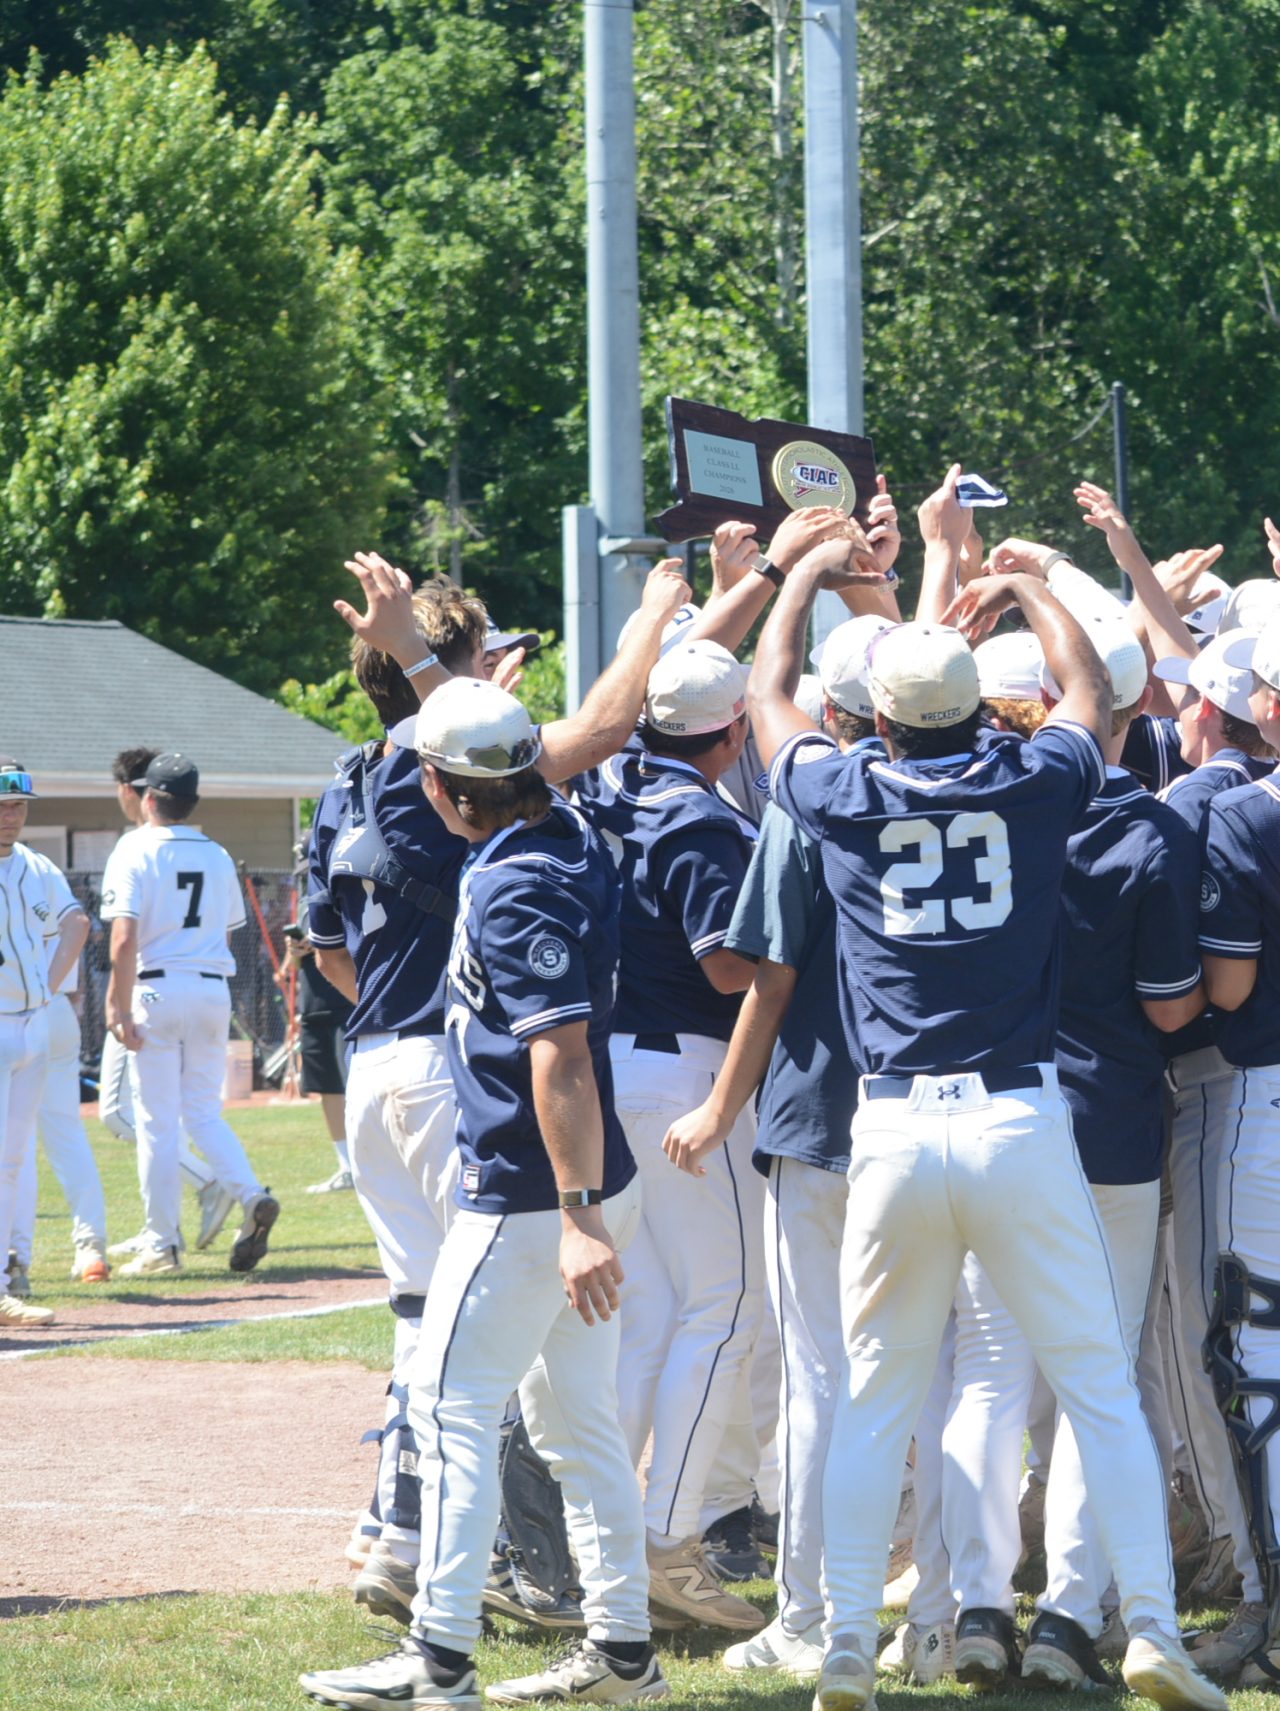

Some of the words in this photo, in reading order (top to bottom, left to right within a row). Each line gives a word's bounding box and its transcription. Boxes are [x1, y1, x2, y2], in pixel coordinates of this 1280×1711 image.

[703, 444, 741, 459] BASEBALL
[706, 457, 730, 469] CLASS
[731, 462, 741, 471] LL
[703, 468, 747, 484] CHAMPIONS
[921, 706, 961, 721] WRECKERS
[878, 811, 1013, 935] 23
[176, 871, 205, 929] 7
[543, 949, 558, 966] S
